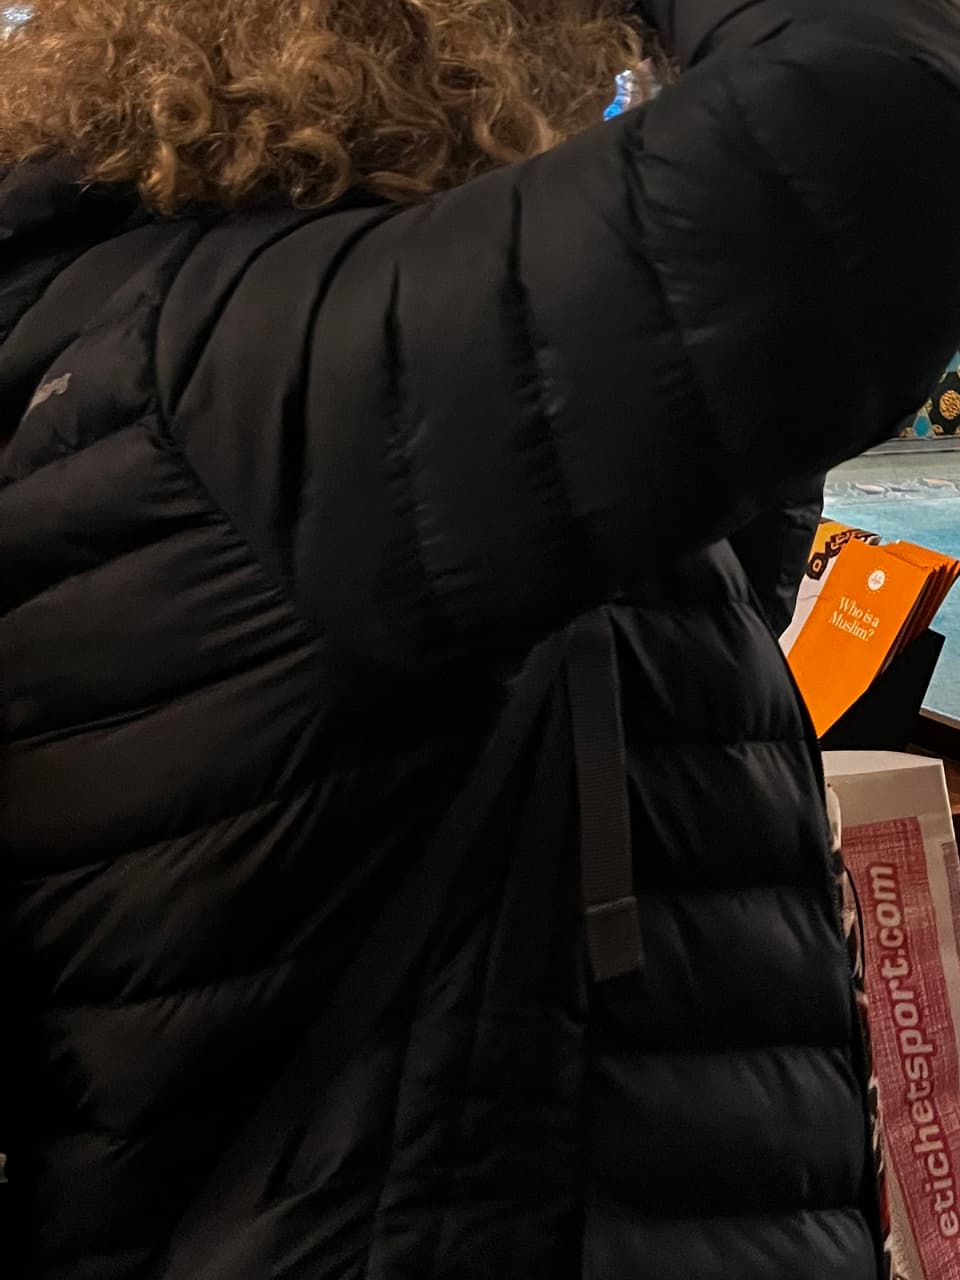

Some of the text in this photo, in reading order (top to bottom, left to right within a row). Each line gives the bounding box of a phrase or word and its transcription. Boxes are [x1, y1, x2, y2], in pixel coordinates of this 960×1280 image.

[828, 610, 875, 642] Muslim?
[839, 596, 880, 628] Who is a
[867, 861, 959, 1238] etichetsport.com
